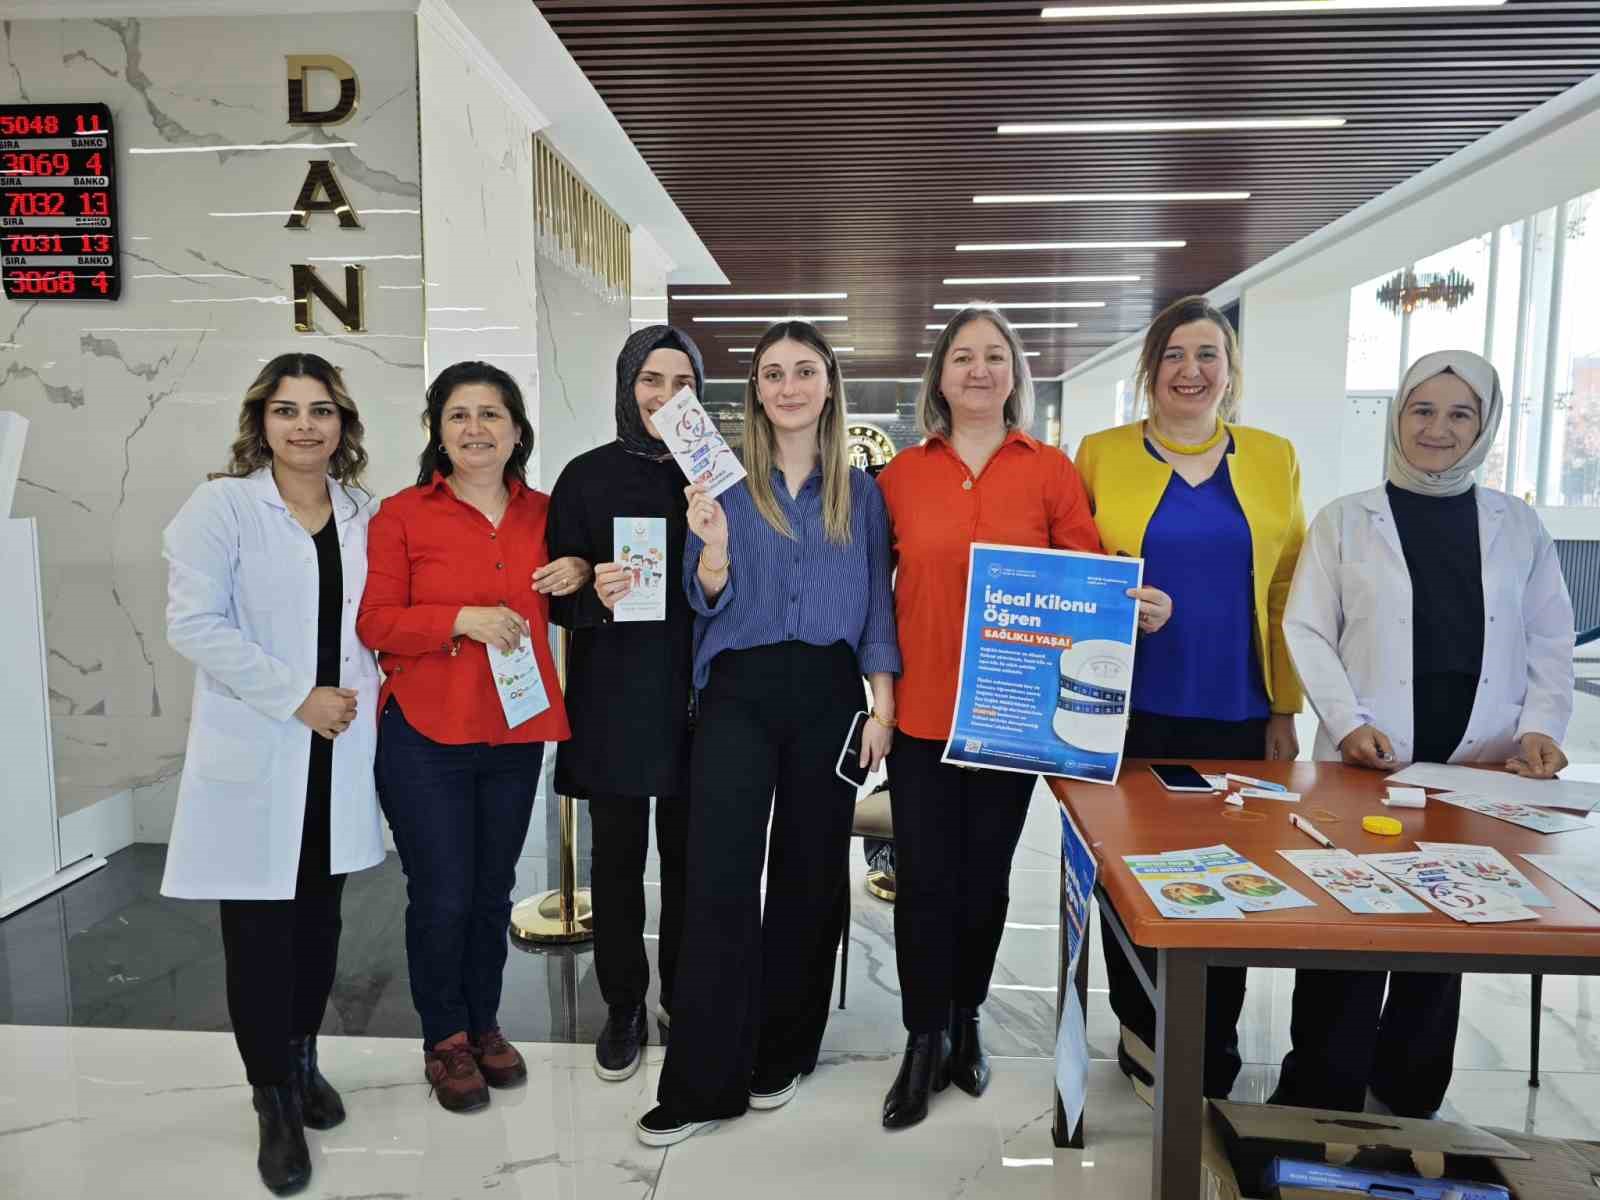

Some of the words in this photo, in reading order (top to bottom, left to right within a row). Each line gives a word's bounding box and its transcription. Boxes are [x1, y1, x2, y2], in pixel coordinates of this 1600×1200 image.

[0, 115, 58, 134] 5048
[75, 114, 99, 134] 11
[71, 138, 104, 148] BANKO
[2, 153, 69, 177] 3069
[86, 152, 102, 177] 4
[0, 177, 22, 186] SIRA
[73, 177, 106, 186] BANKO
[5, 192, 65, 216] 7032
[80, 192, 109, 216] 13
[3, 217, 24, 226] SIRA
[8, 234, 63, 252] 7031
[82, 234, 109, 252] 13
[5, 256, 26, 265] SIRA
[78, 256, 109, 265] BANKO
[9, 270, 75, 294] 3068
[91, 270, 109, 294] 4
[984, 584, 1031, 608] İdeal
[1034, 593, 1097, 614] Kilonu
[983, 603, 1041, 628] Öğren
[984, 628, 1034, 643] SAĞLIKLI
